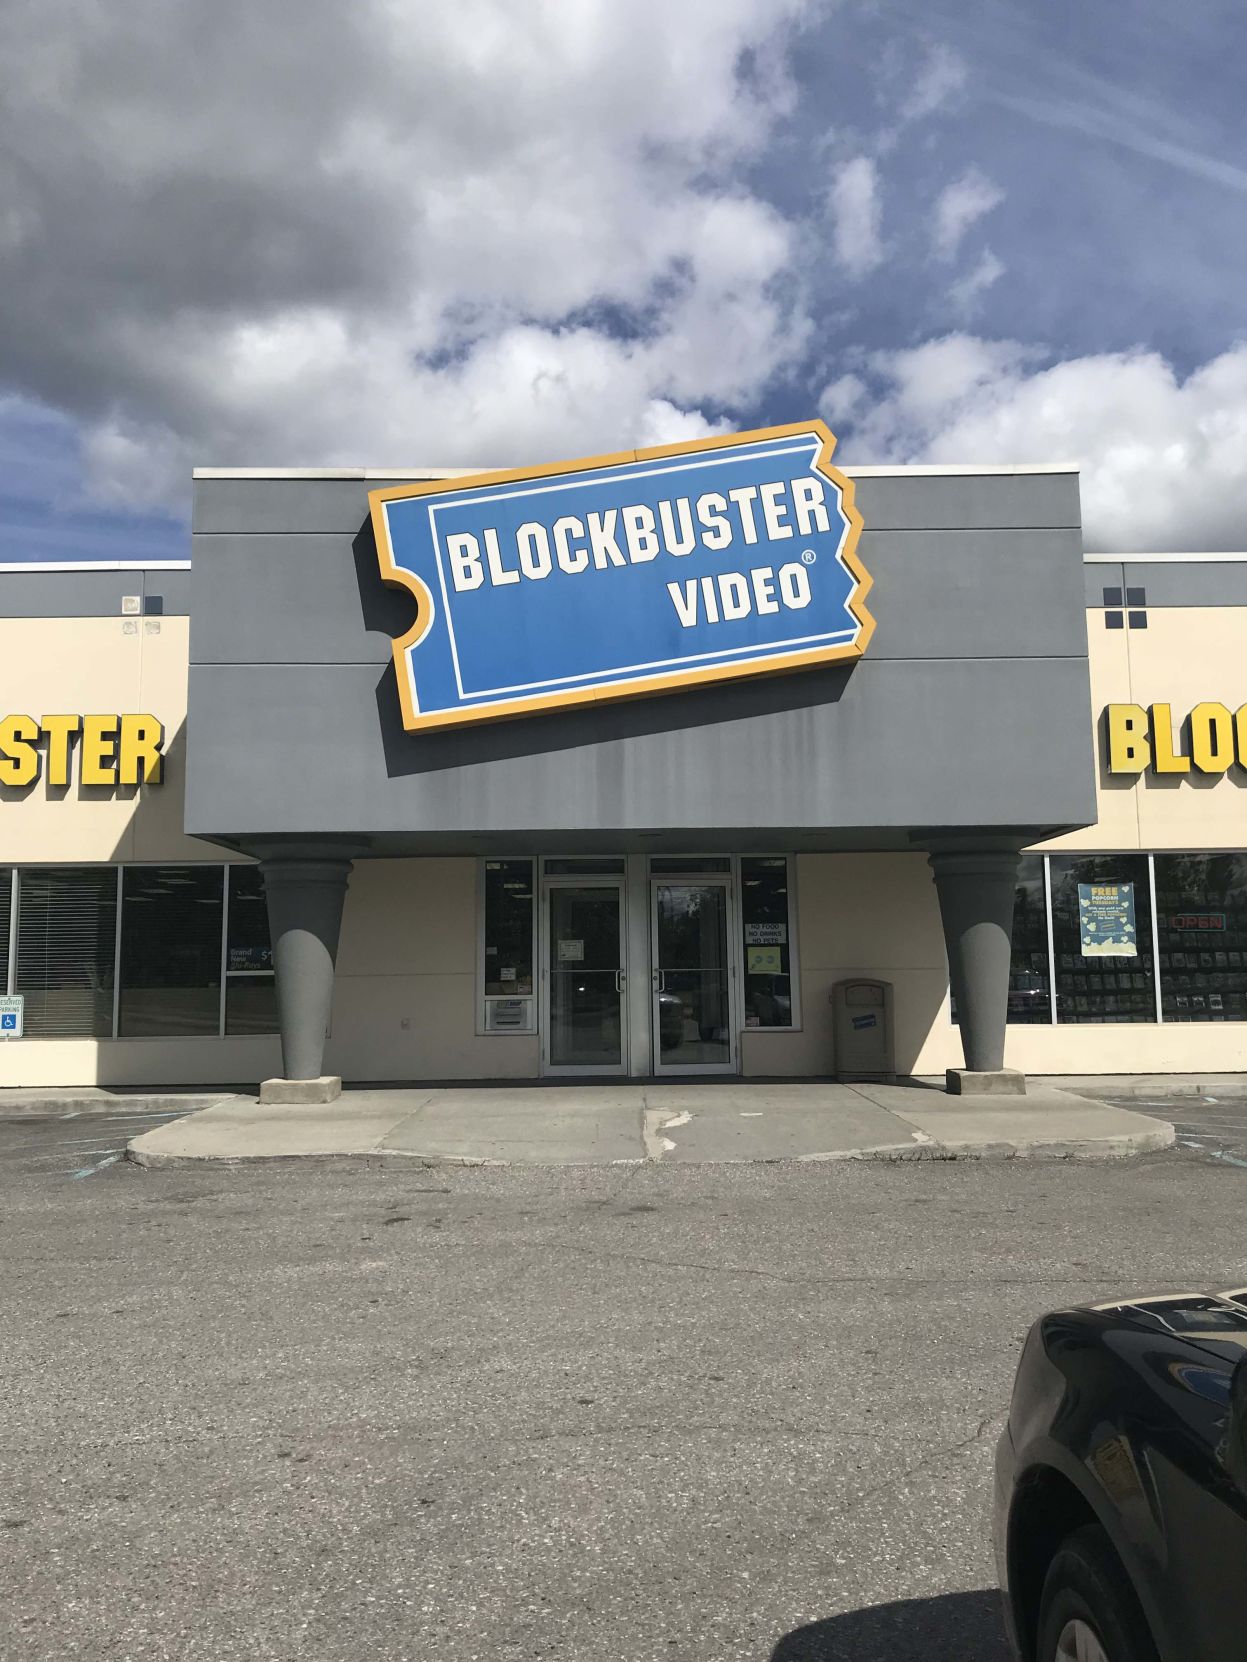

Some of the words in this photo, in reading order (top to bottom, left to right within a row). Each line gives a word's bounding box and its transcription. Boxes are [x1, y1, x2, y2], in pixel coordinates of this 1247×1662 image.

[446, 476, 830, 592] BLOCKBUSTER
[667, 561, 812, 628] VIDEO
[1105, 702, 1247, 775] BLO
[1091, 887, 1118, 896] FREE
[1172, 916, 1222, 928] OPEN
